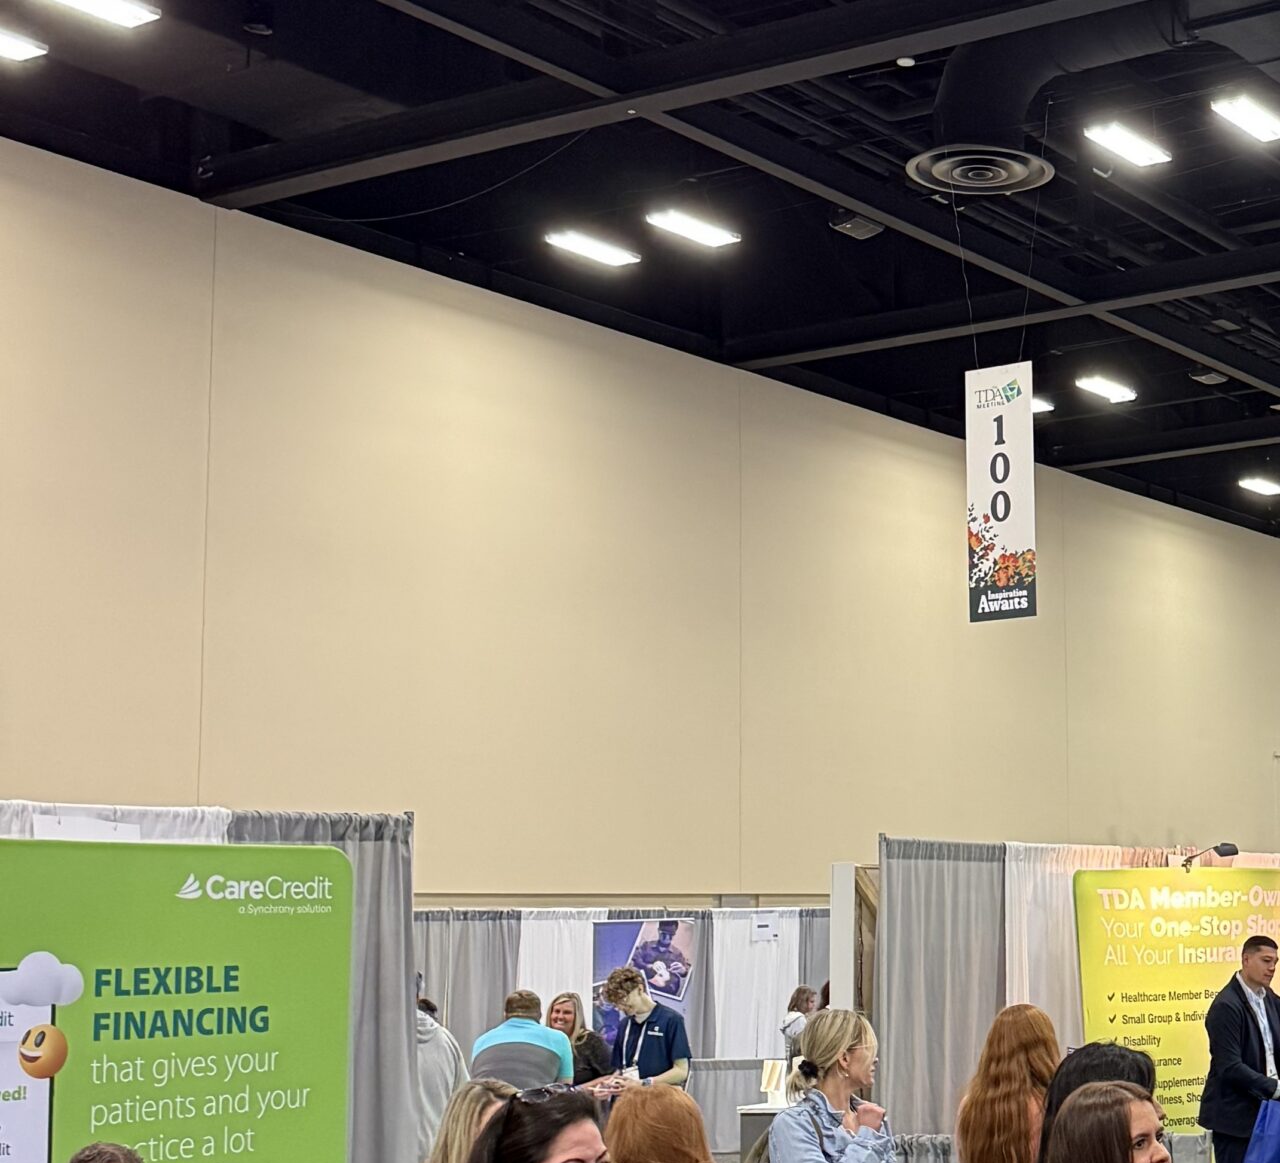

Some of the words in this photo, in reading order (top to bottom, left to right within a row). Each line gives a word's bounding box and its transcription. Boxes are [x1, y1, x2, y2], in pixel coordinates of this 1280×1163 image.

[974, 386, 1003, 403] TDA
[977, 594, 1029, 614] Awaits
[987, 588, 1028, 601] Inspiration
[206, 875, 333, 900] CareCredit
[1096, 887, 1146, 911] TDA
[238, 906, 246, 914] a
[247, 904, 295, 916] Synchrony
[297, 904, 332, 914] solution
[1100, 916, 1145, 939] Your
[1149, 914, 1243, 940] One-Stop
[1104, 943, 1129, 966] All
[1132, 944, 1174, 965] Your
[94, 964, 240, 998] FLEXIBLE
[1121, 991, 1167, 1003] Healthcare
[1168, 989, 1202, 1001] Member
[92, 1004, 270, 1042] FINANCING
[1122, 1013, 1146, 1025] Small
[1147, 1013, 1173, 1025] Group
[1175, 1012, 1181, 1022] &
[1123, 1035, 1161, 1048] Disability
[90, 1053, 145, 1085] that
[153, 1053, 217, 1090] gives
[224, 1048, 280, 1083] your
[90, 1092, 197, 1134] patients
[203, 1084, 250, 1116] and
[257, 1085, 311, 1120] your
[201, 1135, 215, 1157] a
[224, 1125, 255, 1155] lot
